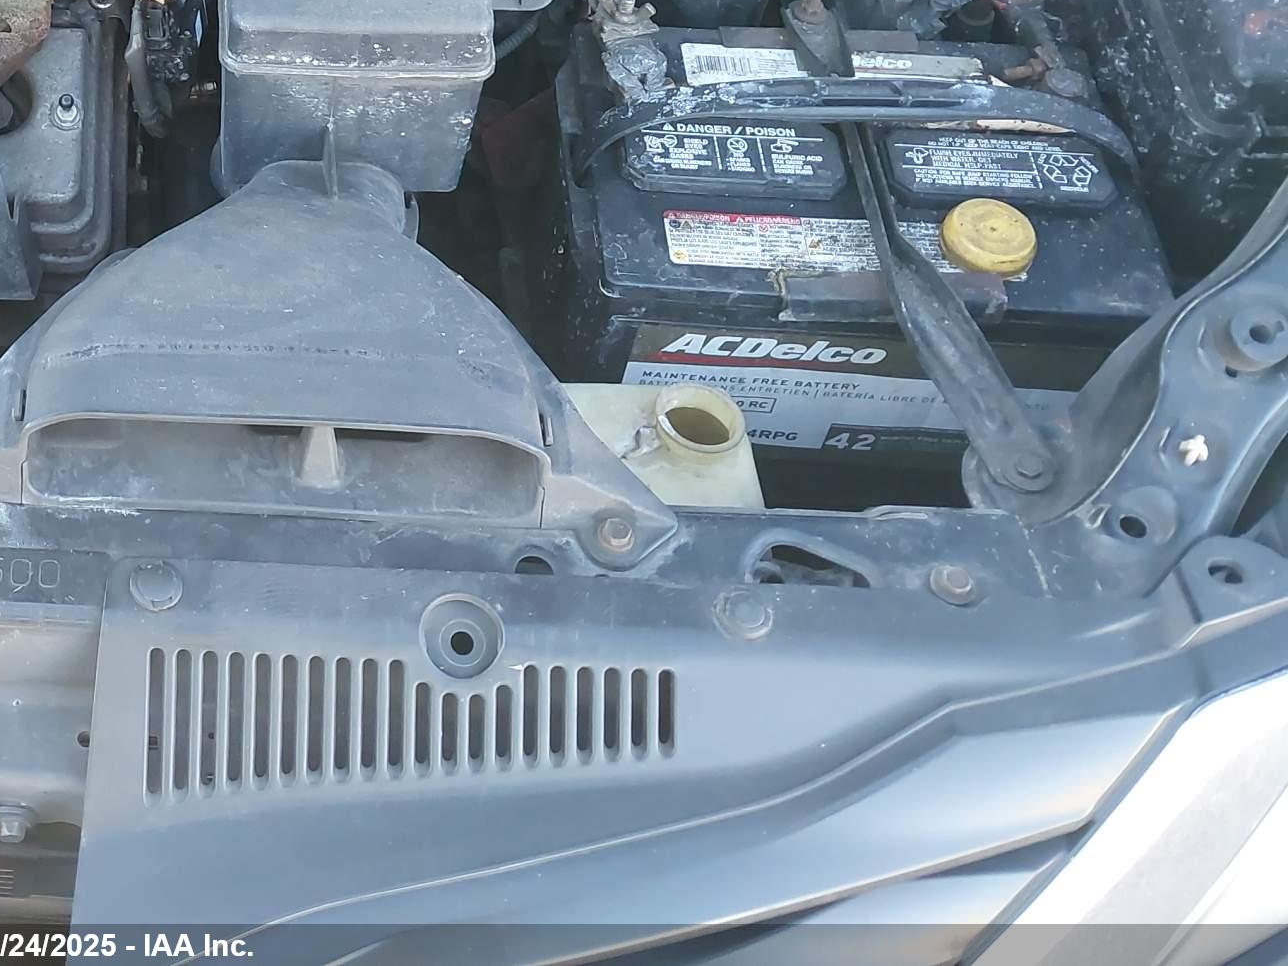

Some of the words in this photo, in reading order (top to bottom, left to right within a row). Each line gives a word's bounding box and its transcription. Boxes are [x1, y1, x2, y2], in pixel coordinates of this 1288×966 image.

[676, 123, 732, 134] DANGER
[746, 126, 796, 137] POISON
[661, 333, 888, 365] ACDelco
[642, 370, 747, 384] MAINTENANCE
[752, 377, 790, 386] FREE
[794, 380, 861, 391] BATTERY
[740, 386, 810, 397] ENTRETIEN
[823, 390, 875, 401] BATERÍA
[880, 395, 918, 403] LIBRE
[748, 400, 770, 409] RC
[825, 433, 877, 451] 42
